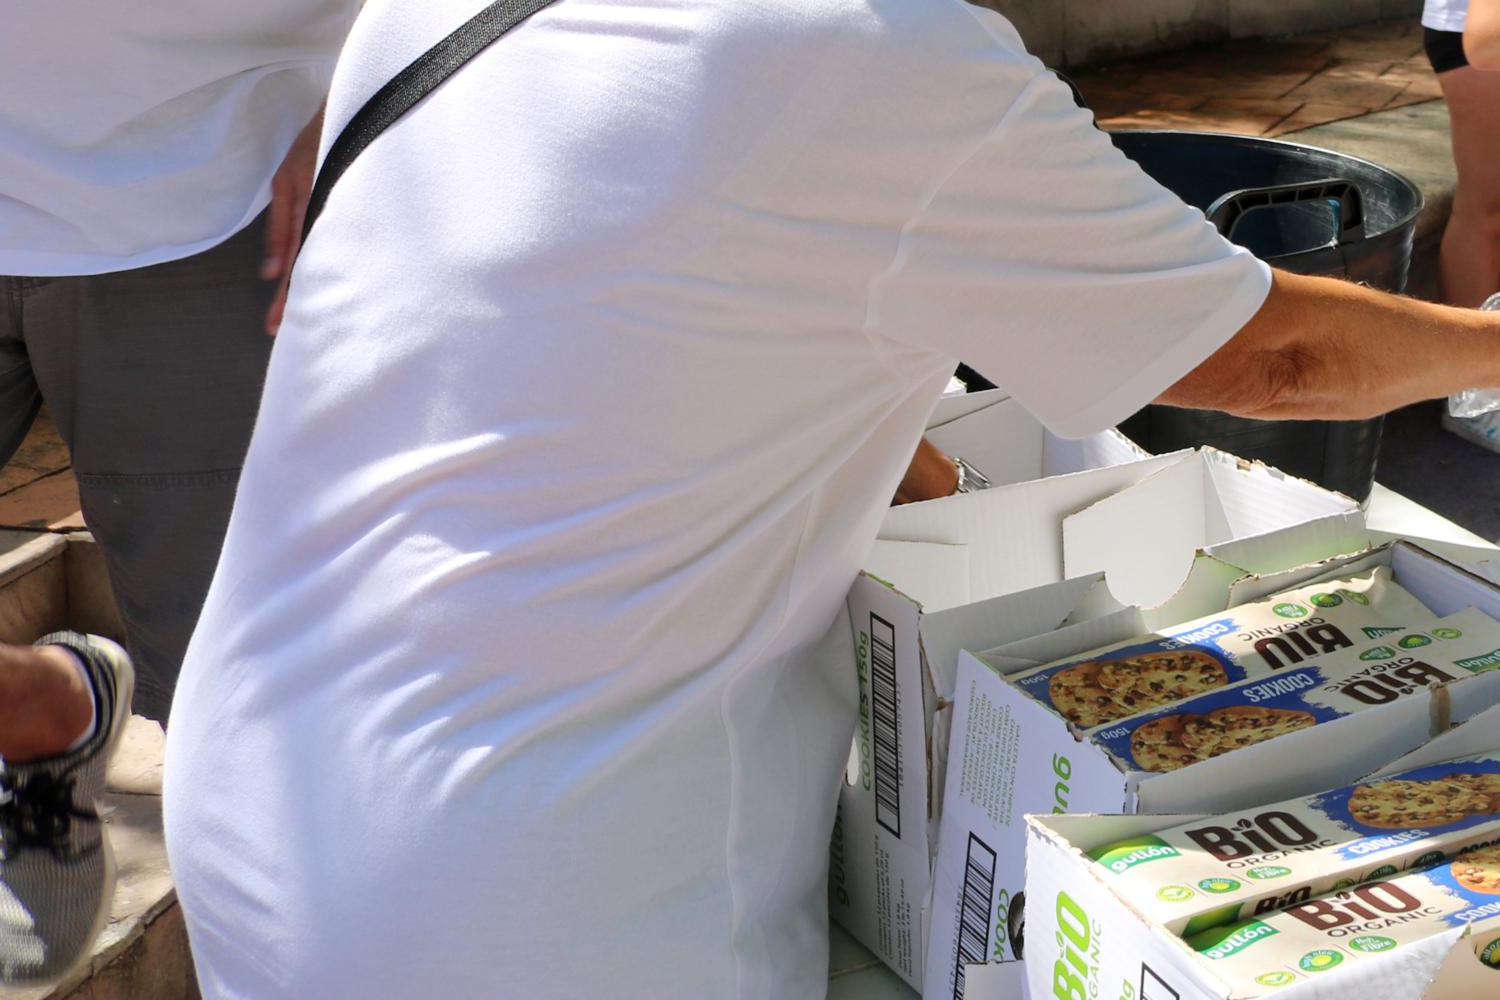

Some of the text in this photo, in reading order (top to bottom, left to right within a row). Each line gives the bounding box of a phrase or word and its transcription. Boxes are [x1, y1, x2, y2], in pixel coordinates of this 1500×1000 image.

[1160, 623, 1230, 651] COOKIES
[1238, 617, 1326, 642] ORGANIC
[1243, 673, 1314, 703] COOKIES
[1324, 657, 1415, 693] ORGANIC
[858, 630, 871, 791] COOKIES 150g
[1101, 728, 1131, 742] 150g
[1226, 839, 1340, 870] ORGANIC
[1348, 828, 1430, 854] COOKIES
[1111, 844, 1175, 873] gullón
[1327, 906, 1442, 938] ORGANIC
[1207, 923, 1273, 959] gullón
